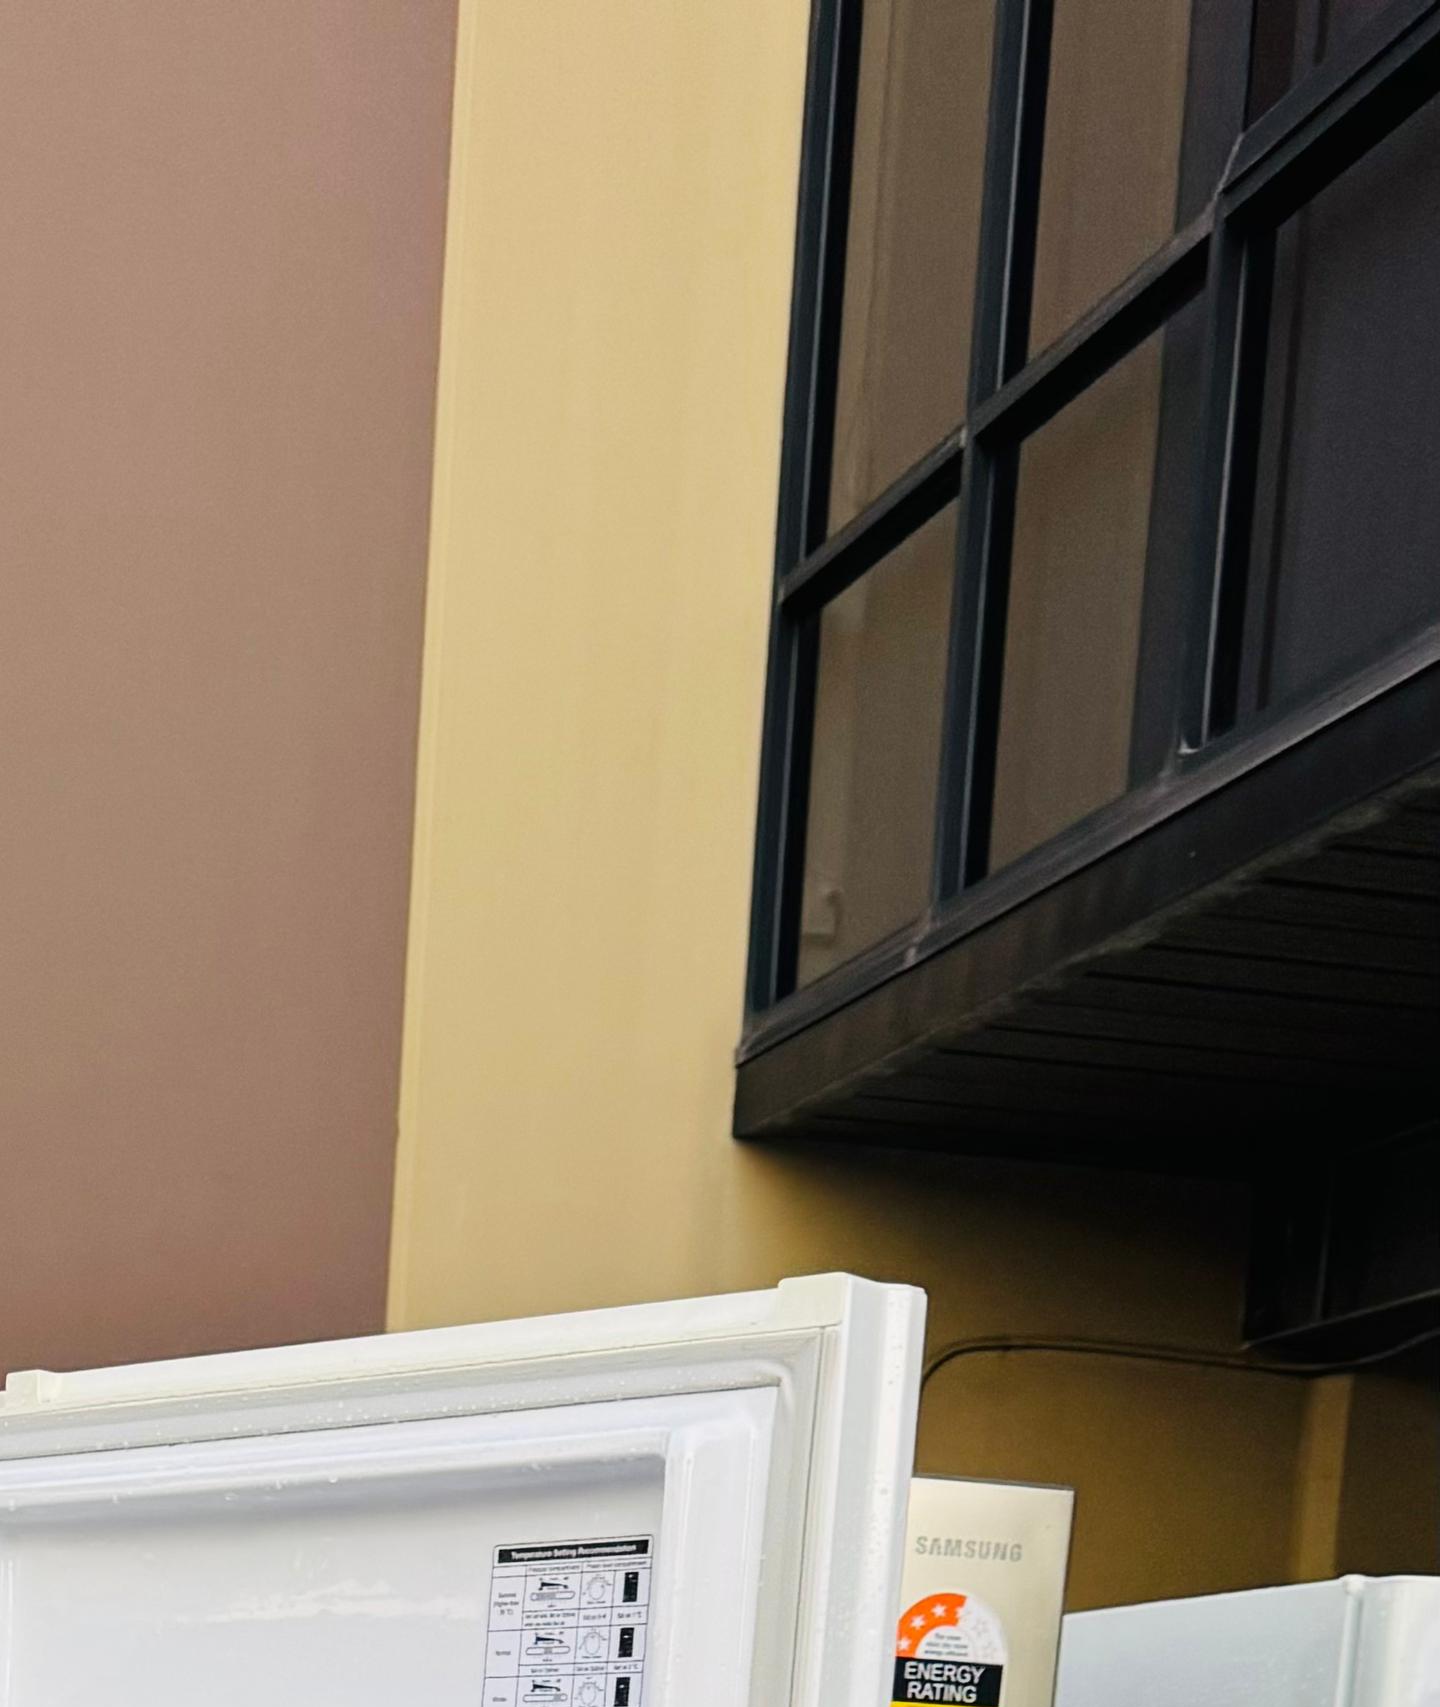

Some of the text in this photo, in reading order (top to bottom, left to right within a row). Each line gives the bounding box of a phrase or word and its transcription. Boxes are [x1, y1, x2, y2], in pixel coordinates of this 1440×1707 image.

[914, 1535, 1023, 1563] SAMSUNG
[904, 1661, 986, 1684] ENERGY
[906, 1681, 977, 1703] RATING
